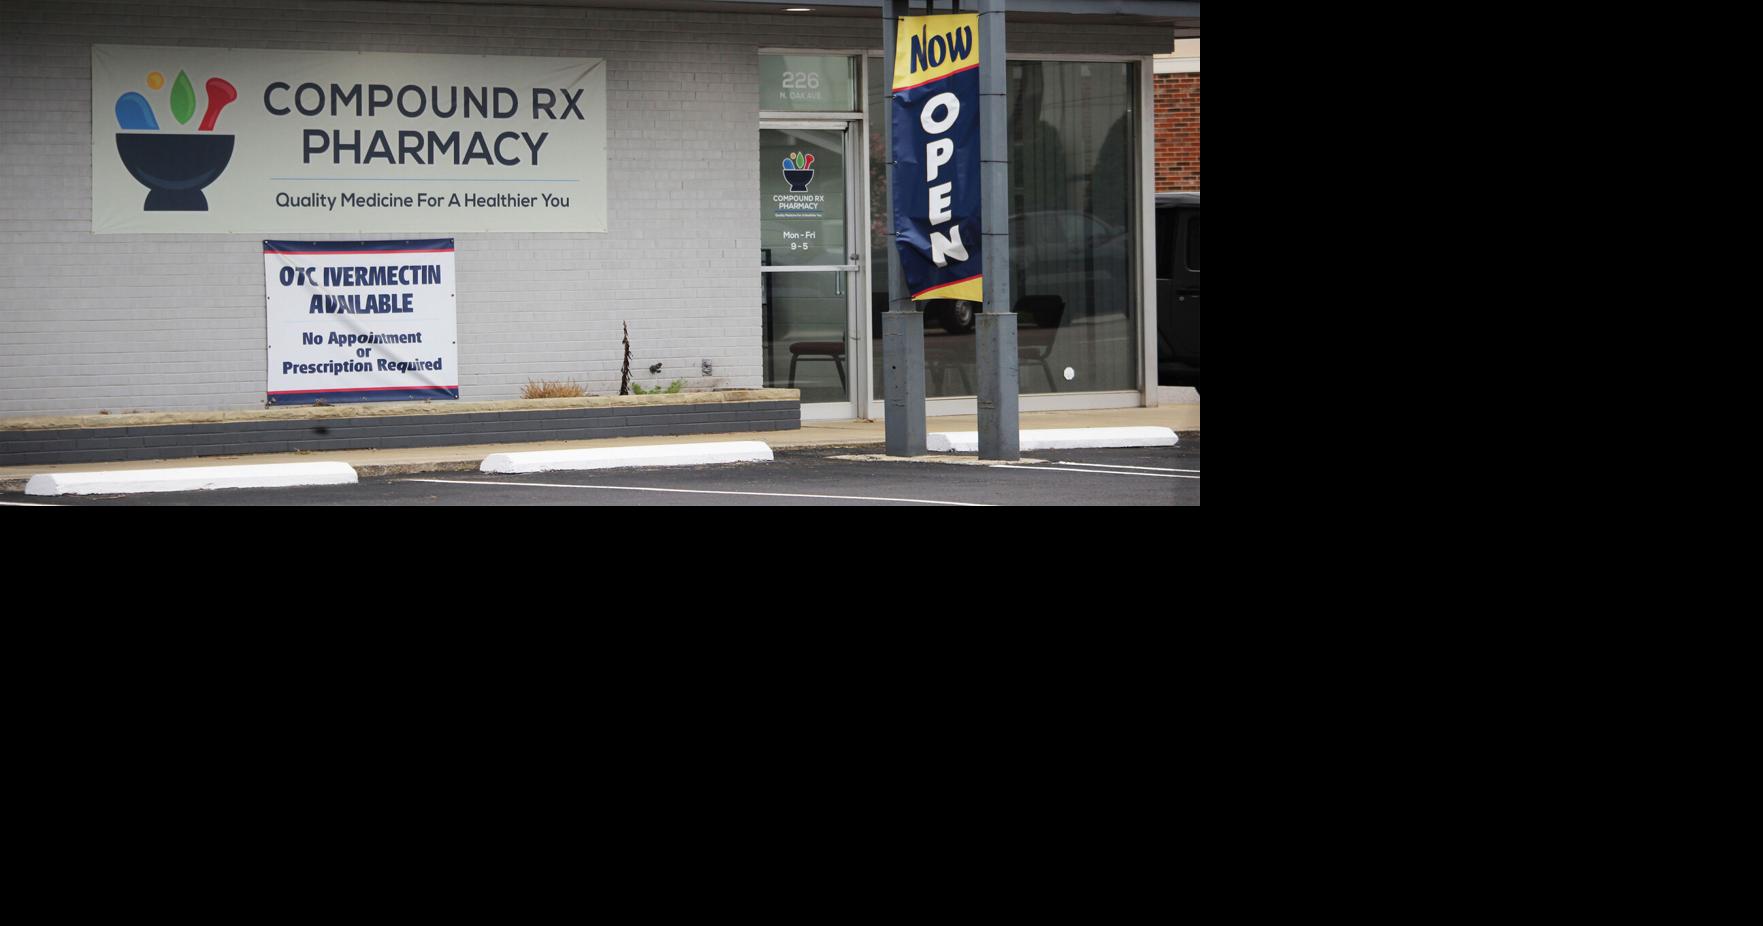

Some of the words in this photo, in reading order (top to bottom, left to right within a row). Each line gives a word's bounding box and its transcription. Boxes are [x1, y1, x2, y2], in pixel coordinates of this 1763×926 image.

[782, 71, 820, 89] 226
[263, 80, 519, 119] COMPOUND
[531, 87, 585, 121] RX
[302, 128, 549, 166] PHARMACY
[919, 91, 970, 269] OPEN
[275, 191, 337, 212] Quality
[340, 192, 414, 208] Medicine
[417, 192, 445, 208] For
[447, 192, 461, 208] A
[464, 192, 538, 208] Healthier
[541, 193, 570, 208] You
[783, 231, 799, 239] Mon
[805, 231, 816, 239] Fri
[279, 265, 319, 287] OTC
[323, 264, 441, 287] IVERMECTIN
[309, 293, 414, 314] AVAILABLE
[302, 331, 324, 346] No
[327, 331, 422, 348] Appointment
[356, 347, 372, 358] or
[282, 360, 373, 376] Prescription
[376, 358, 443, 374] Required
